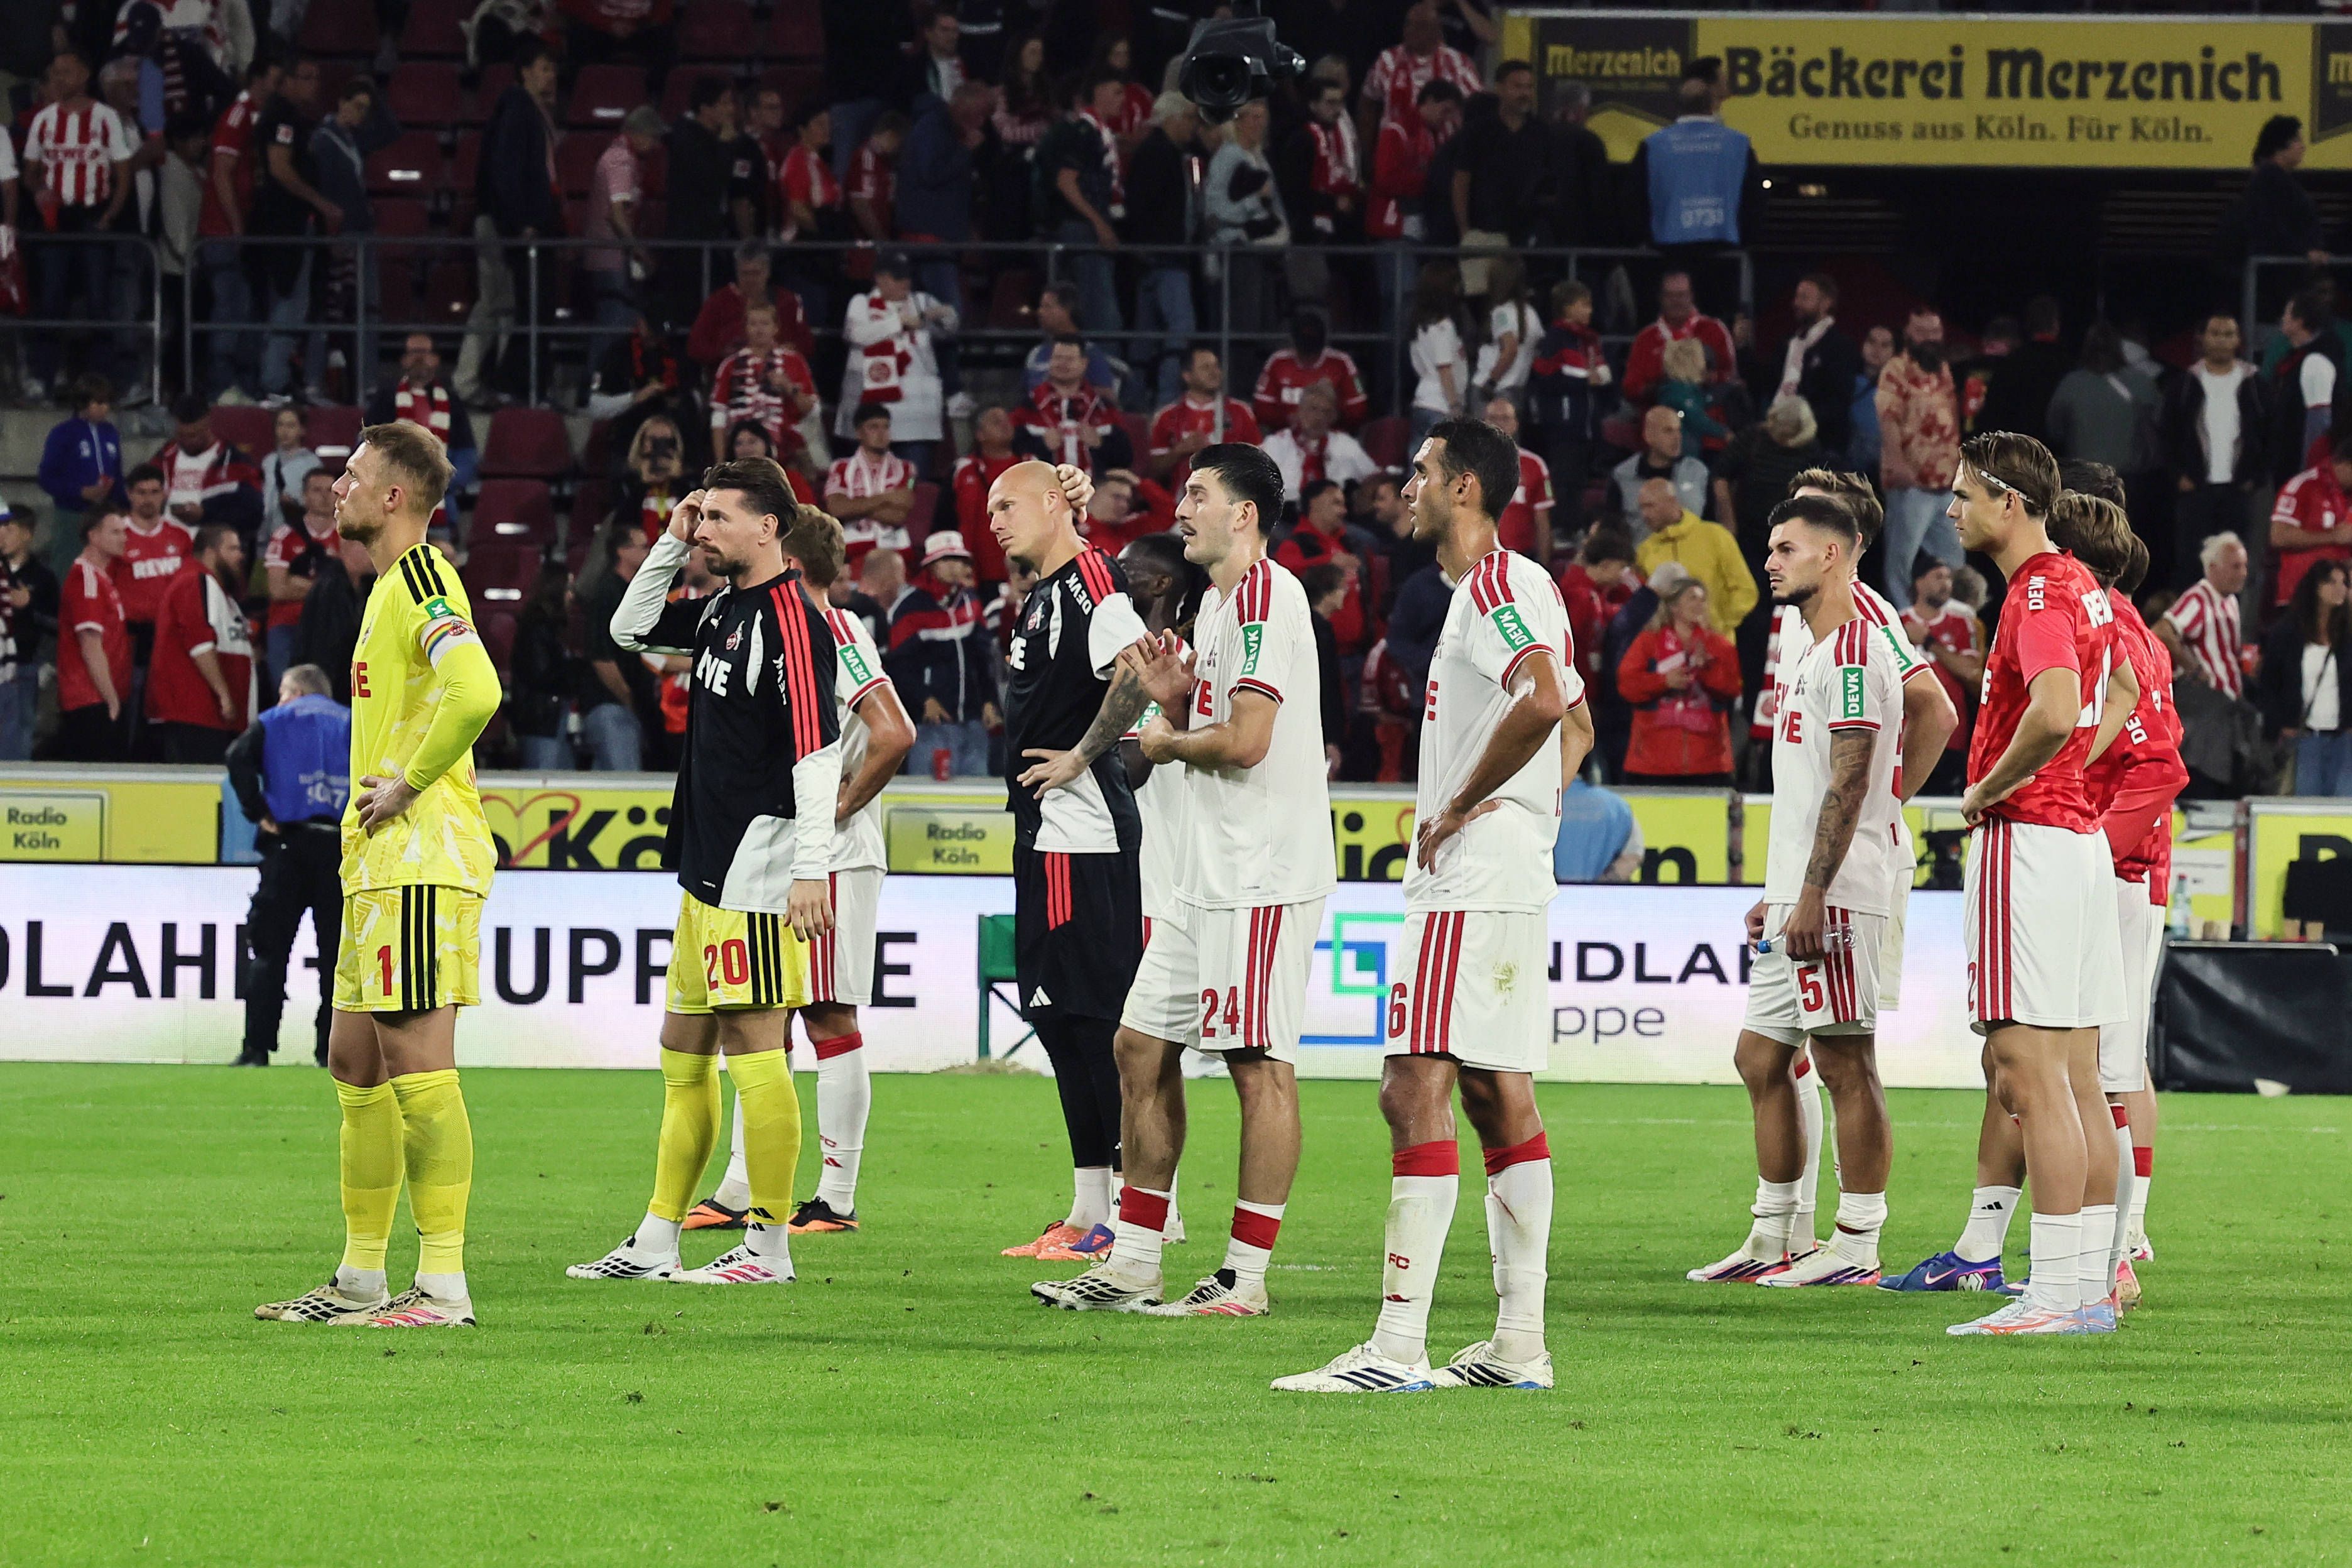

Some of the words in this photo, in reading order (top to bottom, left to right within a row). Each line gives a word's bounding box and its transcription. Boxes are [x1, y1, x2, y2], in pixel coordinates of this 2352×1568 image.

[1545, 44, 1682, 77] Merzenich
[1726, 43, 1964, 100] Bäckerei
[1986, 45, 2282, 102] Merzenich
[1788, 114, 1903, 141] Genuss
[1912, 120, 1964, 141] aus
[1975, 114, 2056, 143] Köln.
[2067, 116, 2120, 143] Für
[2130, 116, 2213, 143] Köln.
[1064, 572, 1092, 616] DEVK
[2027, 575, 2046, 611] DEVK
[1498, 609, 1530, 647] DEVK
[842, 648, 870, 682] DEVK
[1244, 628, 1260, 673] DEVK
[1847, 672, 1861, 714] DEVK
[7, 806, 67, 825] Radio
[927, 822, 986, 841] Radio
[14, 830, 60, 849] Köln
[933, 847, 979, 864] Köln
[378, 944, 392, 996] 1
[704, 939, 749, 991] 20
[1797, 964, 1824, 1012] 5
[1201, 986, 1240, 1037] 24
[1388, 983, 1407, 1038] 6
[1388, 1252, 1410, 1270] FC
